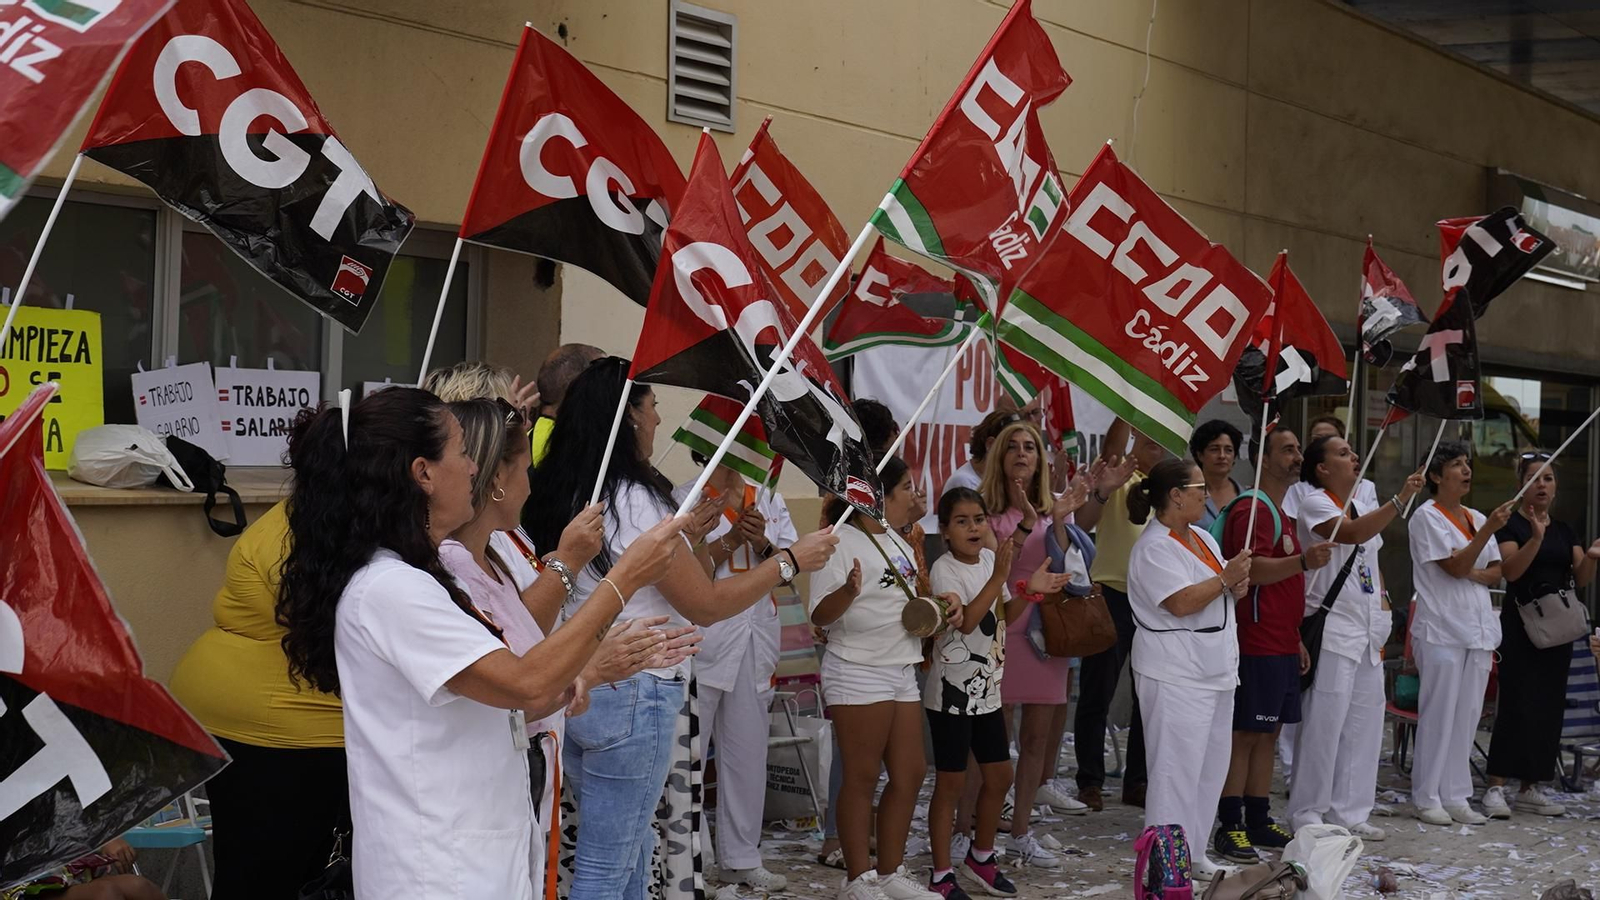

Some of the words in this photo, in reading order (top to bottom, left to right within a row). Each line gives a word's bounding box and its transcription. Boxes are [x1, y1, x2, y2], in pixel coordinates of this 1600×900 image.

[153, 35, 383, 242] CGT
[732, 148, 846, 312] COO
[340, 287, 355, 299] CGT
[1062, 181, 1250, 362] CCOO
[2, 325, 92, 364] IMPIEZA
[1125, 309, 1210, 392] Cádiz
[149, 381, 193, 406] TRABAJO
[232, 385, 310, 407] TRABAJO
